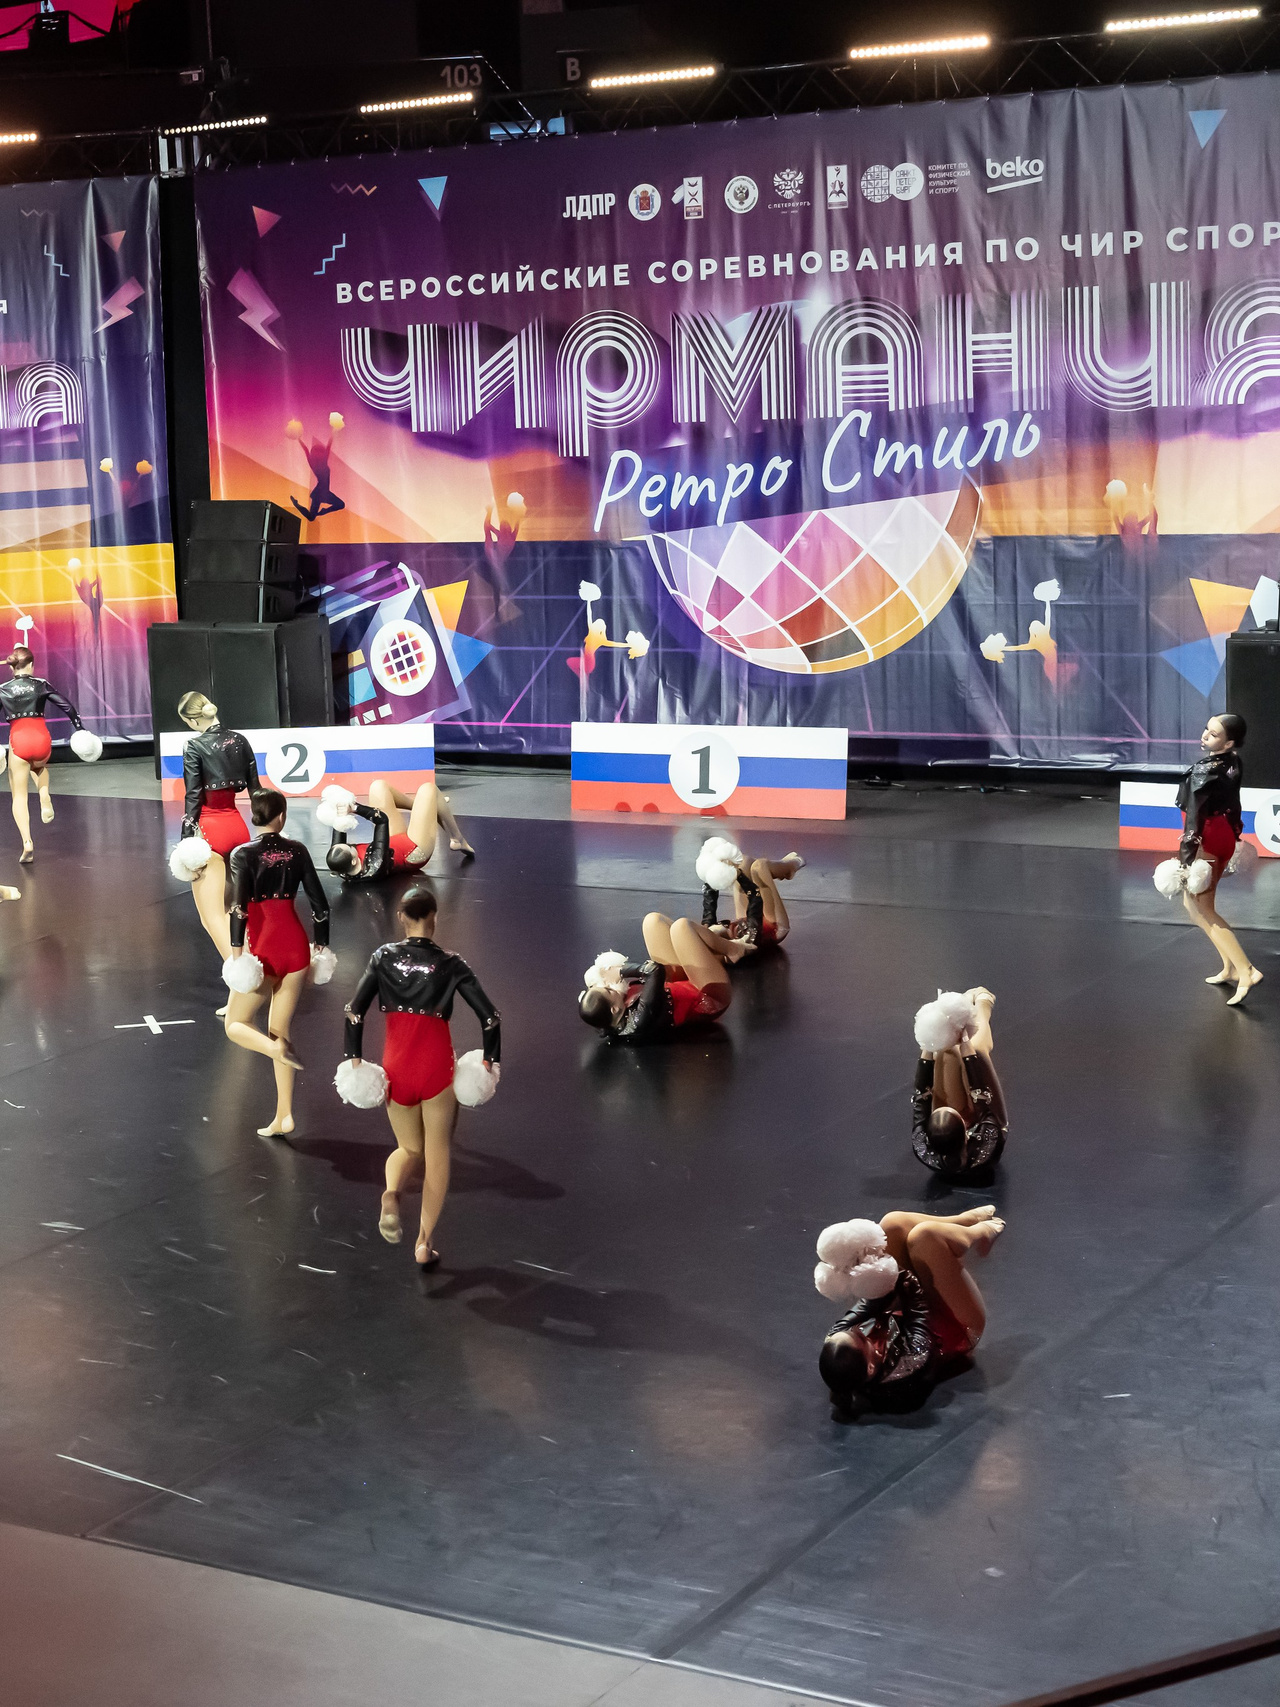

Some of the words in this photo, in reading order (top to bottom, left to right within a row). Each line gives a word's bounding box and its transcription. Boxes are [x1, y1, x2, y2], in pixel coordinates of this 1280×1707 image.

[440, 63, 483, 88] 103
[928, 163, 957, 171] КОМИТЕТ
[928, 169, 971, 179] ФИЗИЧЕСКОЙ
[986, 156, 1044, 179] beko
[928, 179, 958, 187] КУЛЬТУРЕ
[562, 193, 616, 221] ЛДПР
[336, 263, 630, 304] ВСЕРОССИЙСКИЕ
[647, 241, 963, 284] СОРЕВНОВАНИЯ
[985, 236, 1040, 263] ПО
[1060, 230, 1144, 258] ЧИР
[593, 449, 794, 532] Ретро
[821, 409, 1041, 493] Стиль
[281, 743, 310, 783] 2
[691, 745, 717, 795] 1
